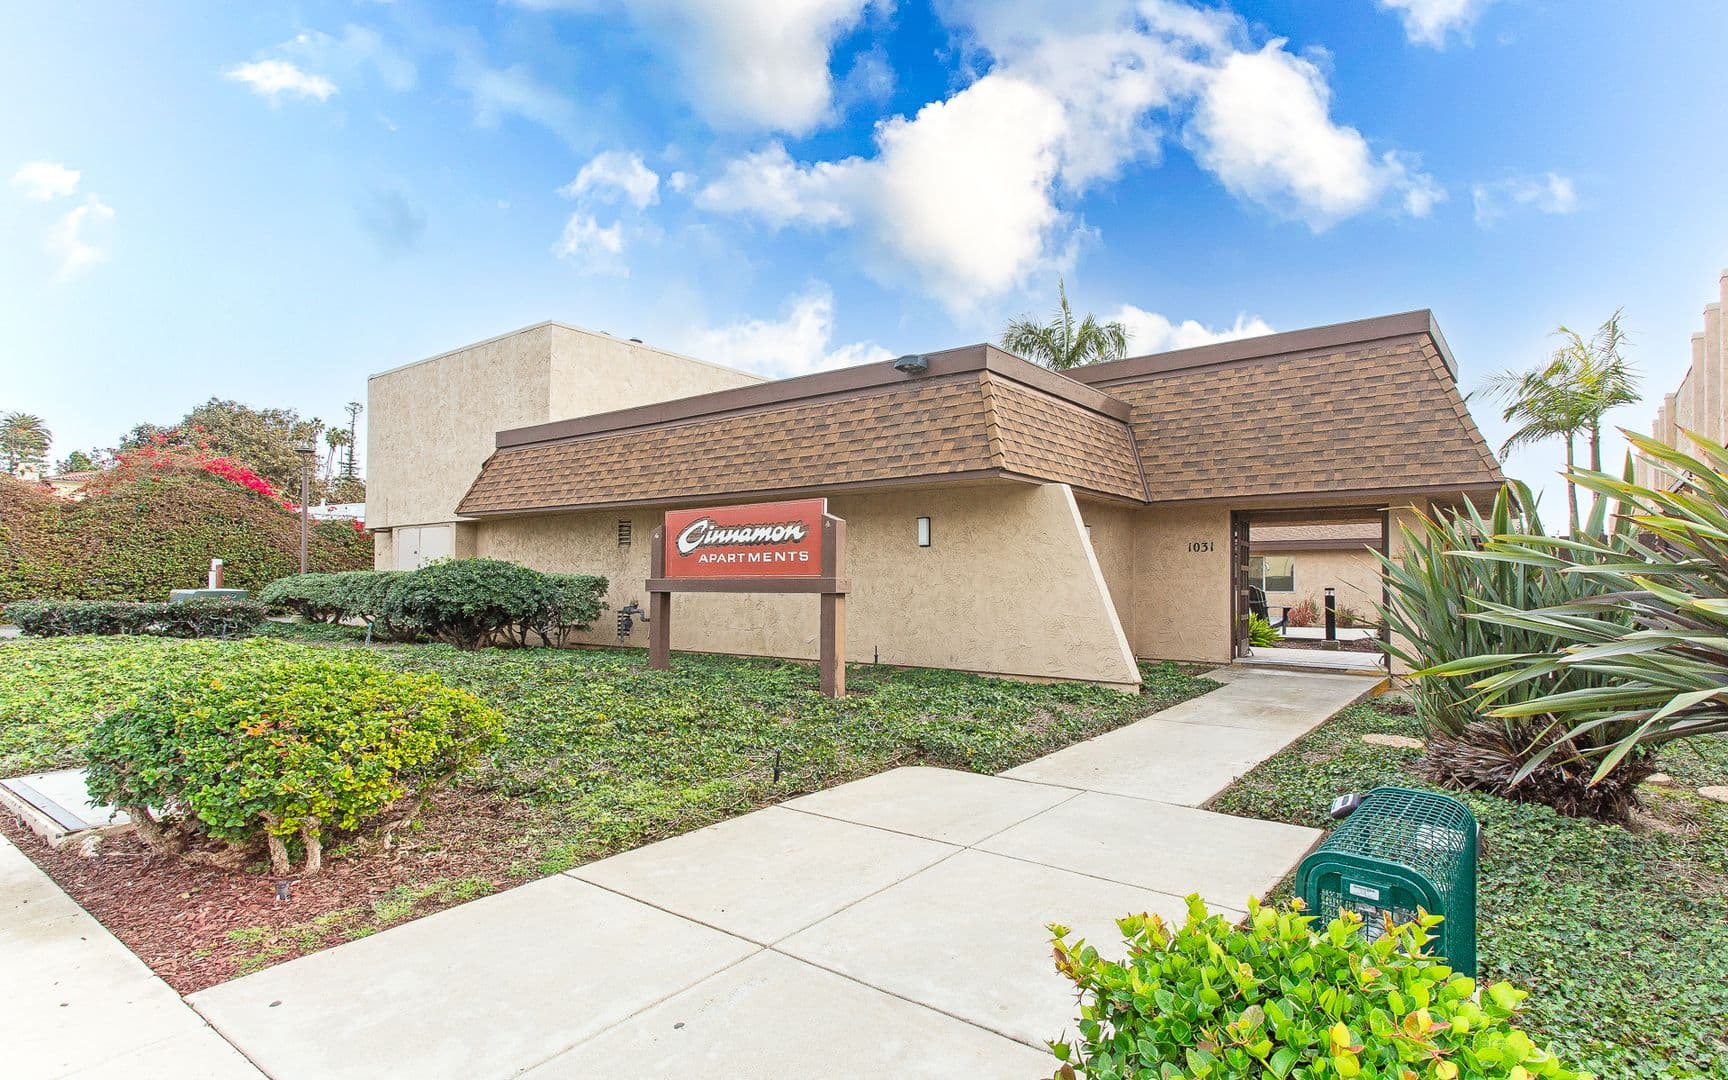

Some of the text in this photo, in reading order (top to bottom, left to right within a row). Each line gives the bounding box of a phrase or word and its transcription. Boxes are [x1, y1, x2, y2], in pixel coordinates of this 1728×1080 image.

[677, 518, 807, 555] Cinnamon
[1188, 541, 1214, 553] 1031
[698, 551, 809, 563] APARTMENTS
